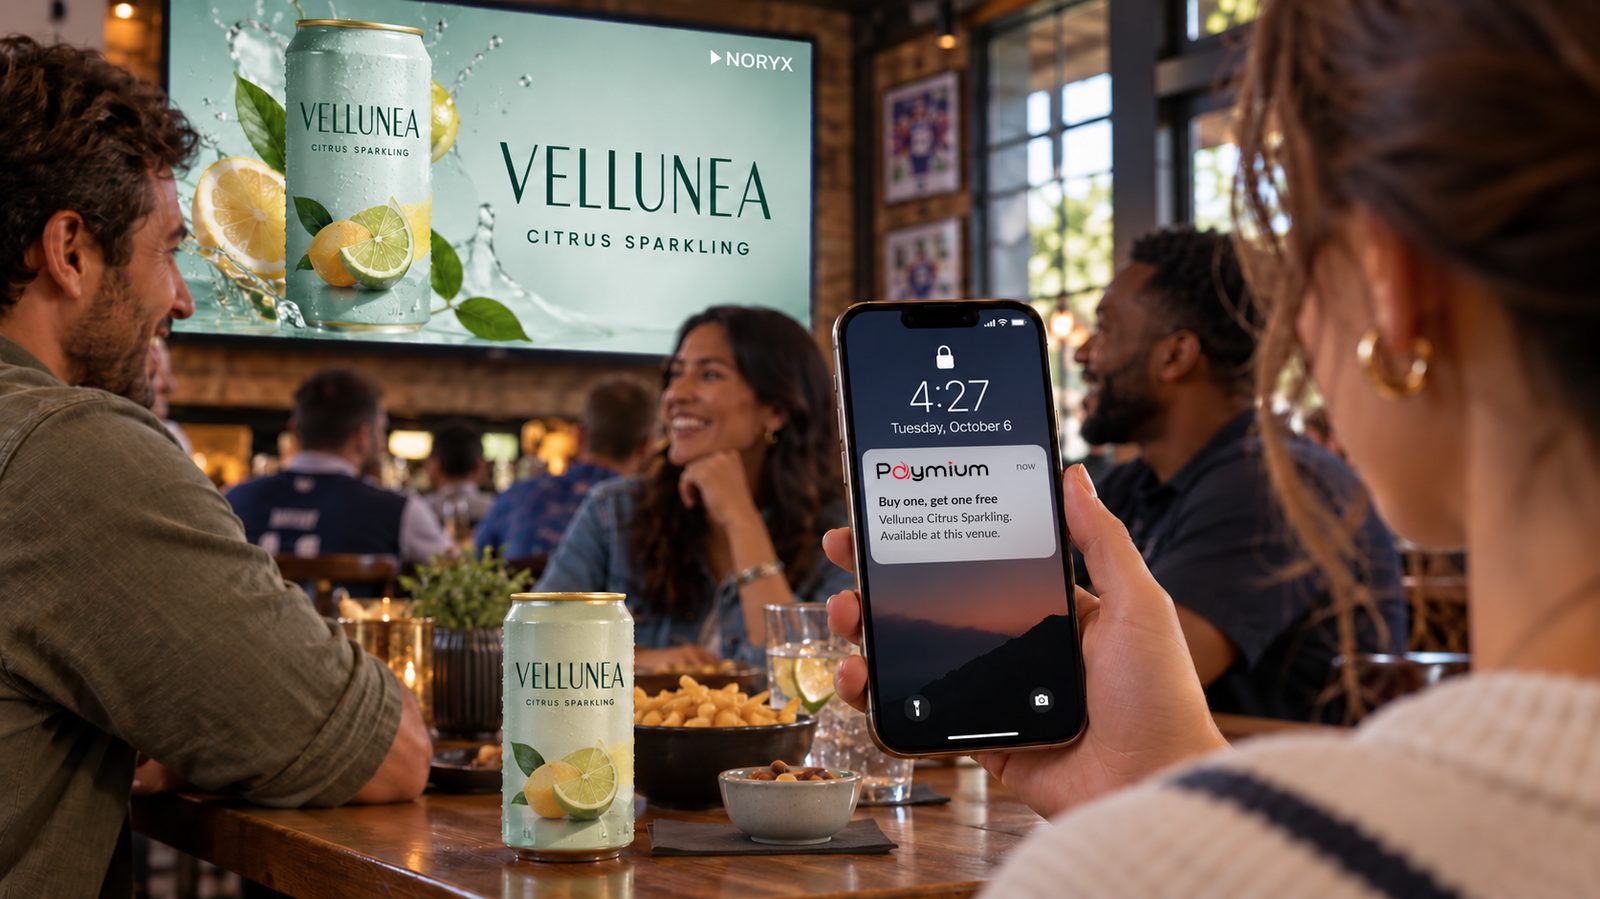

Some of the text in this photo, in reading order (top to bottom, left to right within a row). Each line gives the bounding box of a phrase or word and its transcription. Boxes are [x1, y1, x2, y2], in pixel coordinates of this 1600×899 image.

[726, 50, 793, 72] NORYX
[300, 102, 420, 139] VELLUNEA
[311, 144, 410, 157] CITRUS SPARKLING
[499, 141, 772, 220] VELLUNEA
[526, 229, 751, 256] CITRUS SPARKLING
[910, 379, 989, 413] 4:27
[891, 419, 1012, 435] Tuesday, October 6
[876, 460, 989, 482] Paymium
[1016, 462, 1036, 471] now
[879, 494, 998, 508] Buy one, get one free
[879, 511, 1012, 525] Vellunea Citrus Sparkling.
[880, 529, 1000, 541] Available at this venue.
[515, 662, 625, 689] VELLUNEA
[526, 698, 615, 707] CITRUS SPARKLING
